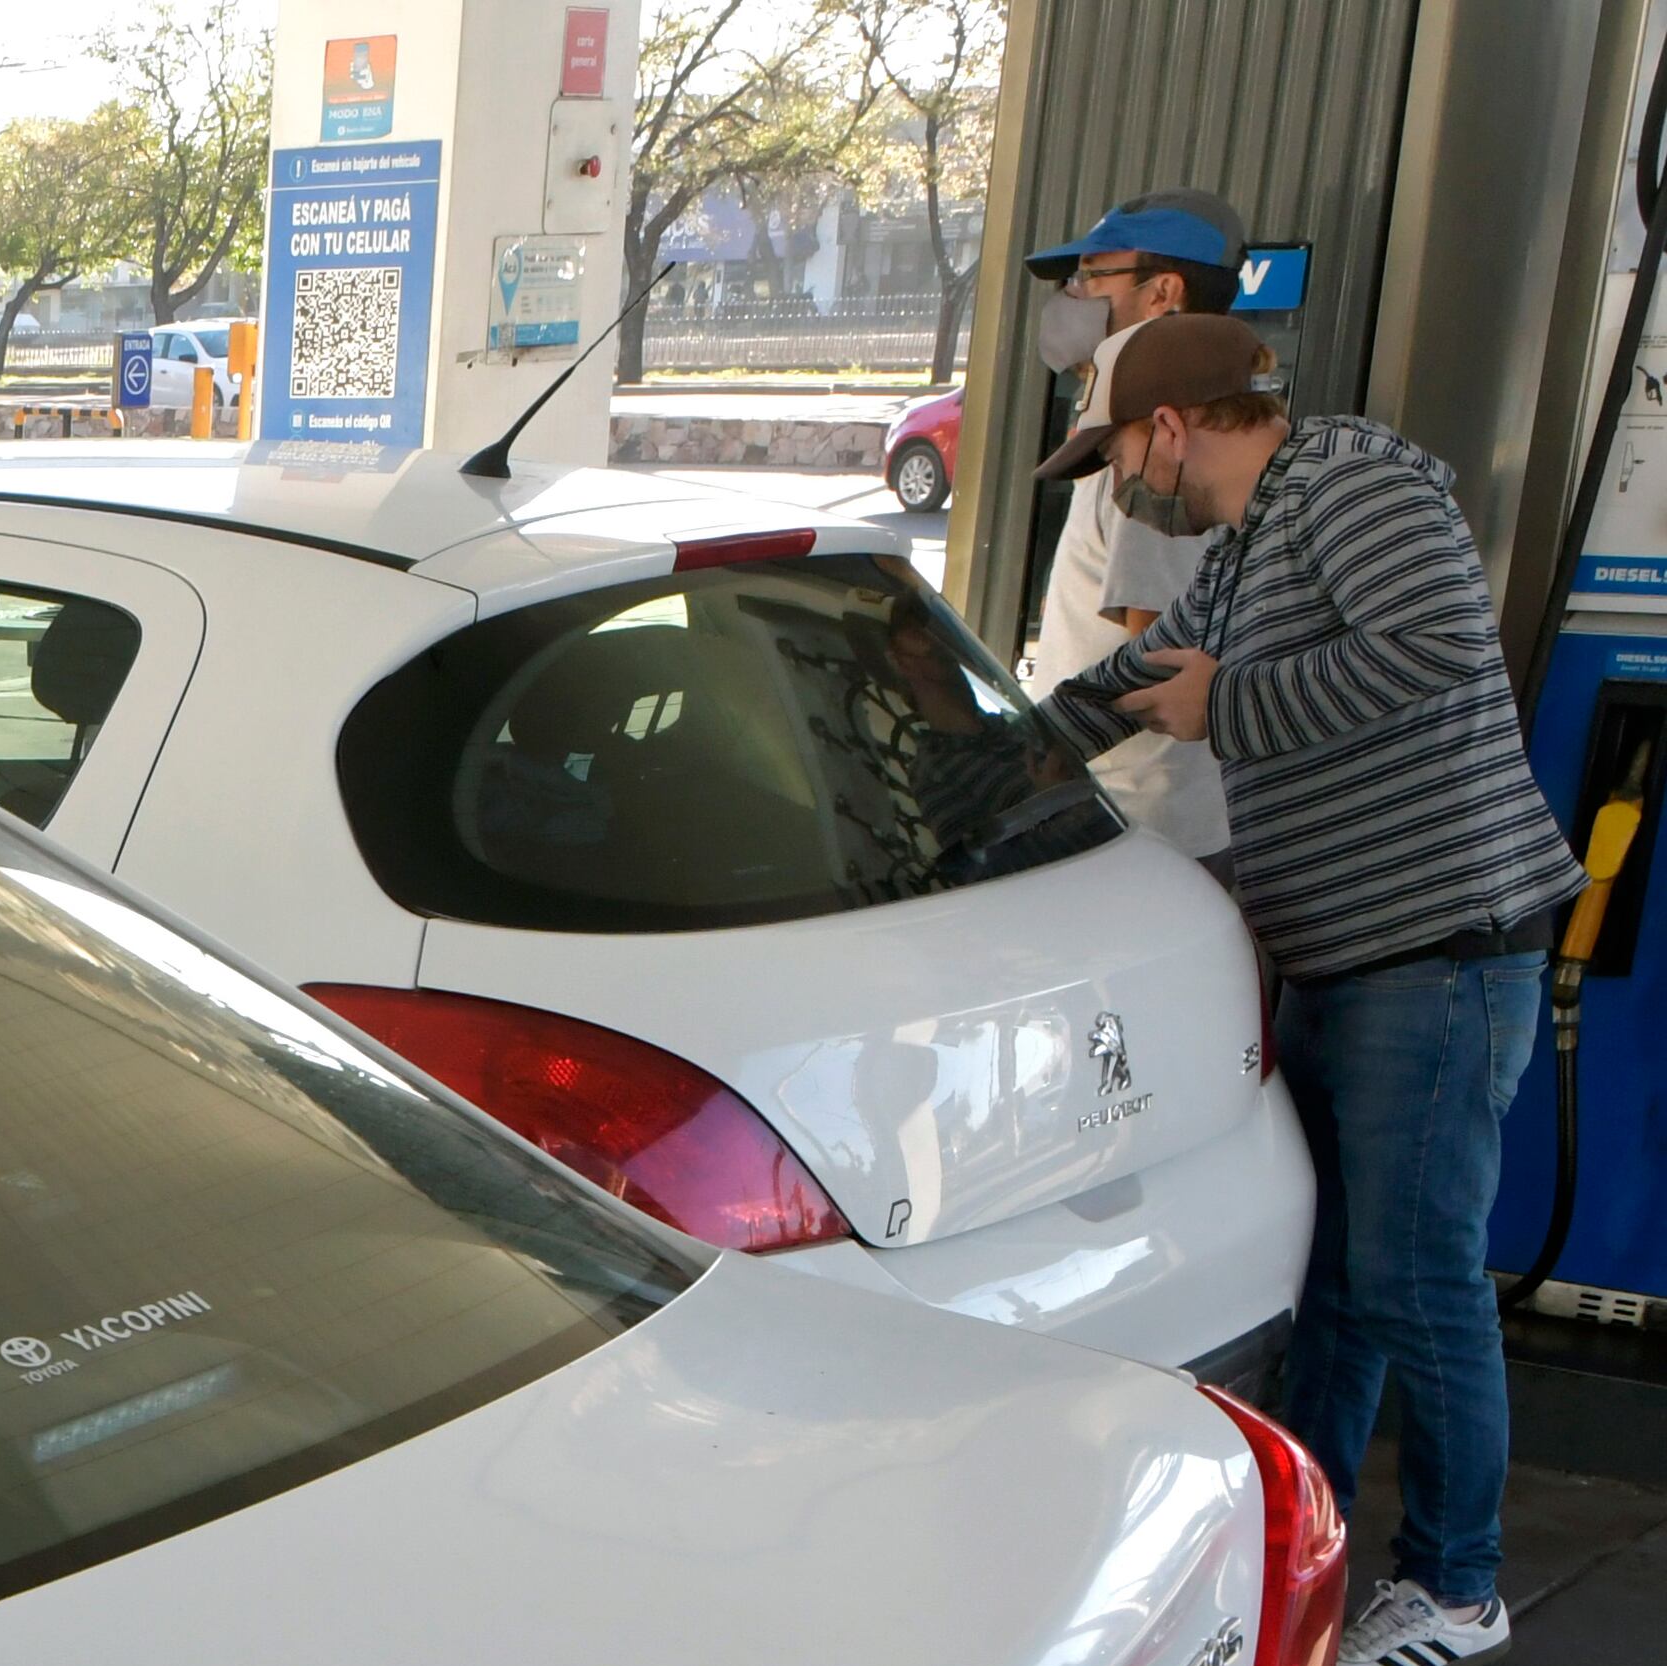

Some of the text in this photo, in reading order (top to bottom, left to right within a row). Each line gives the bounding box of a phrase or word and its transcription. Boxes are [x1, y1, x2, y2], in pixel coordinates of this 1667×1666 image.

[292, 192, 411, 226] ESCANEÁ Y PAGÁ
[290, 229, 411, 257] CON TU CELULAR
[1077, 1092, 1153, 1133] PEUGEOT
[59, 1290, 212, 1351] YACOPINI
[19, 1358, 80, 1385] TOYOTA
